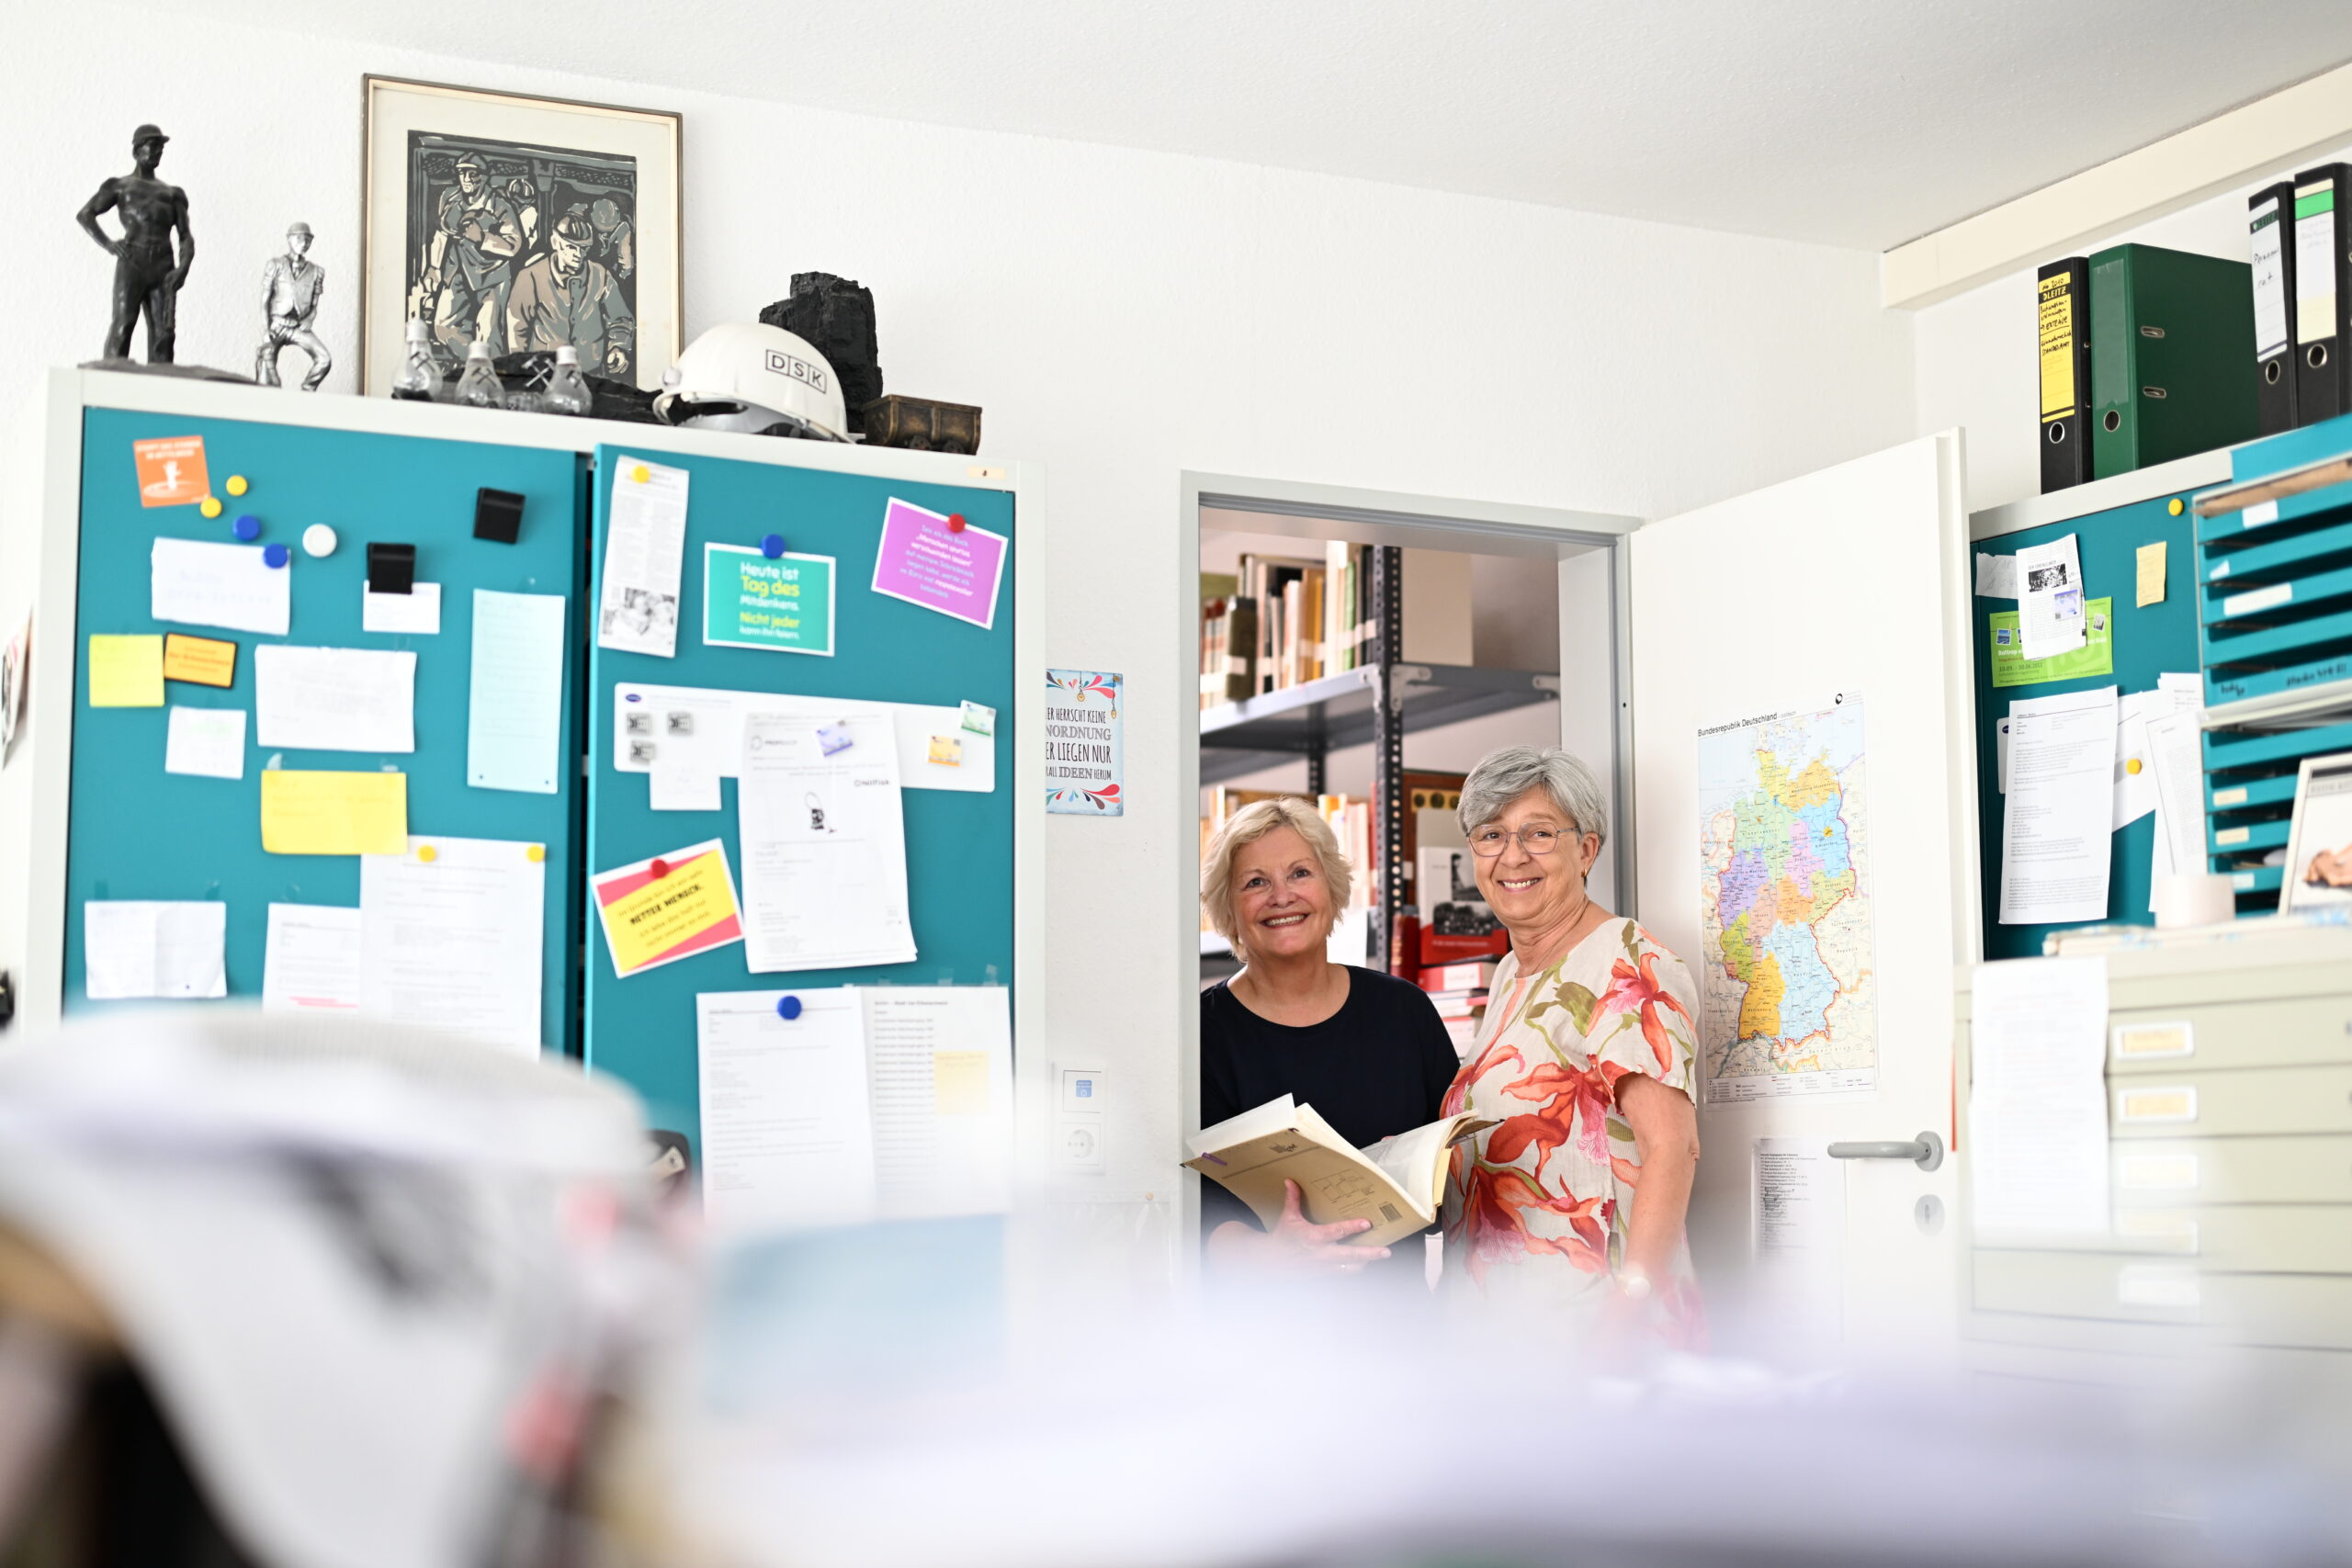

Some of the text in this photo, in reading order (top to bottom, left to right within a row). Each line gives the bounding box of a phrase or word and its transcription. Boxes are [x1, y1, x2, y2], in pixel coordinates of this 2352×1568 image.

[2048, 286, 2066, 299] LEITZ
[772, 355, 822, 388] DSK
[740, 561, 799, 581] Heute ist
[741, 575, 800, 598] Tag des
[739, 611, 800, 629] Nicht jeder
[1046, 706, 1106, 724] ER HERRSCHT KEINE
[1698, 720, 1741, 737] Bundesrepublik
[1742, 713, 1778, 728] Deutschland
[1057, 741, 1090, 762] LIEGEN
[1092, 744, 1112, 764] NUR
[1058, 766, 1092, 780] IDEEN
[1093, 768, 1112, 781] HERUM
